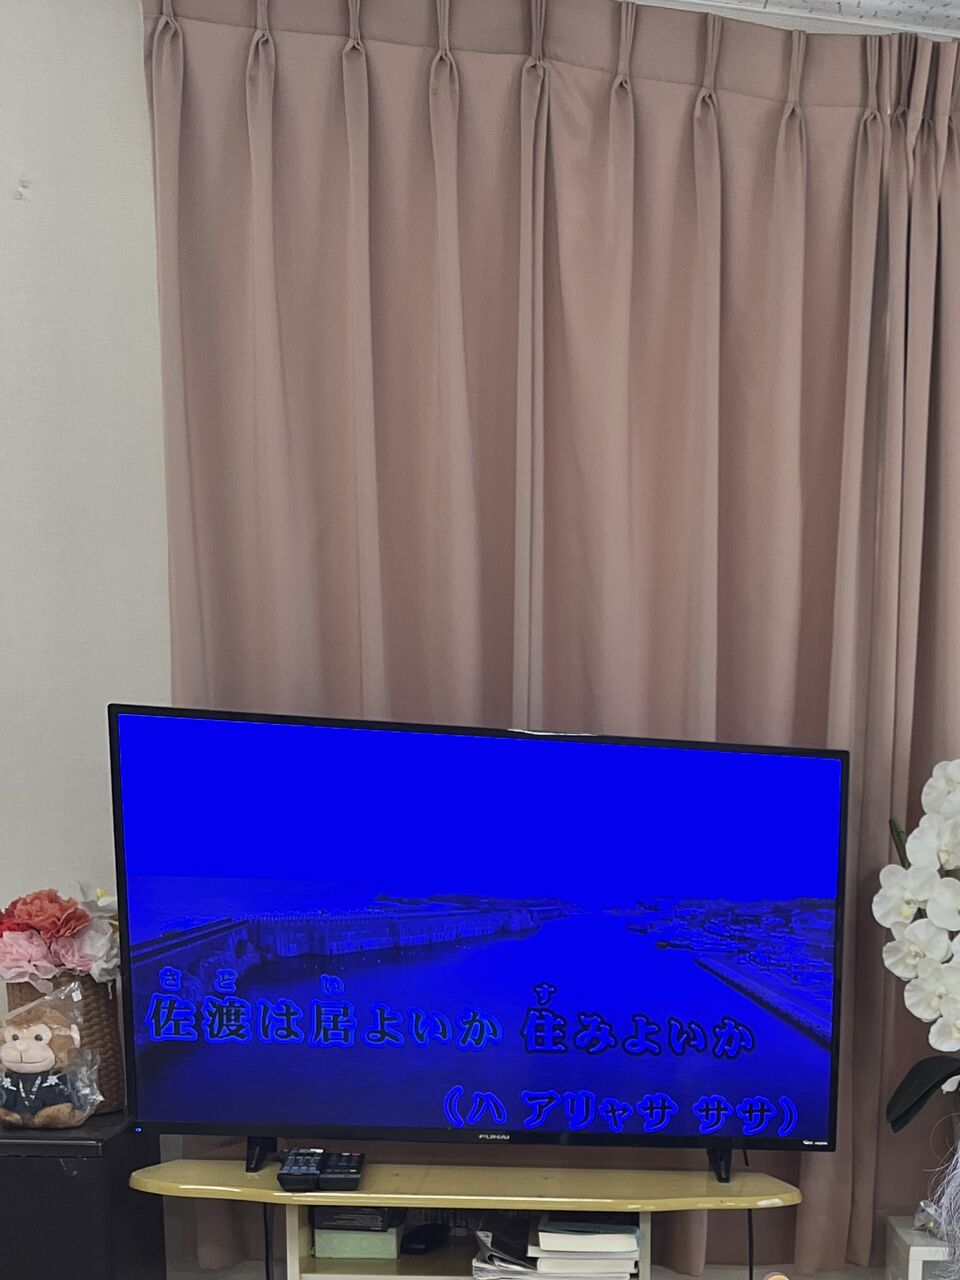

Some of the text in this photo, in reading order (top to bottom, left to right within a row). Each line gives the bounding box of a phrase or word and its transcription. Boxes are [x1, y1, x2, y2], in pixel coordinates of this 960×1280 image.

[160, 968, 557, 1005] さ ど い す
[147, 995, 755, 1060] 佐渡は居よいか 住みよいか
[520, 1089, 678, 1134] アリャサ
